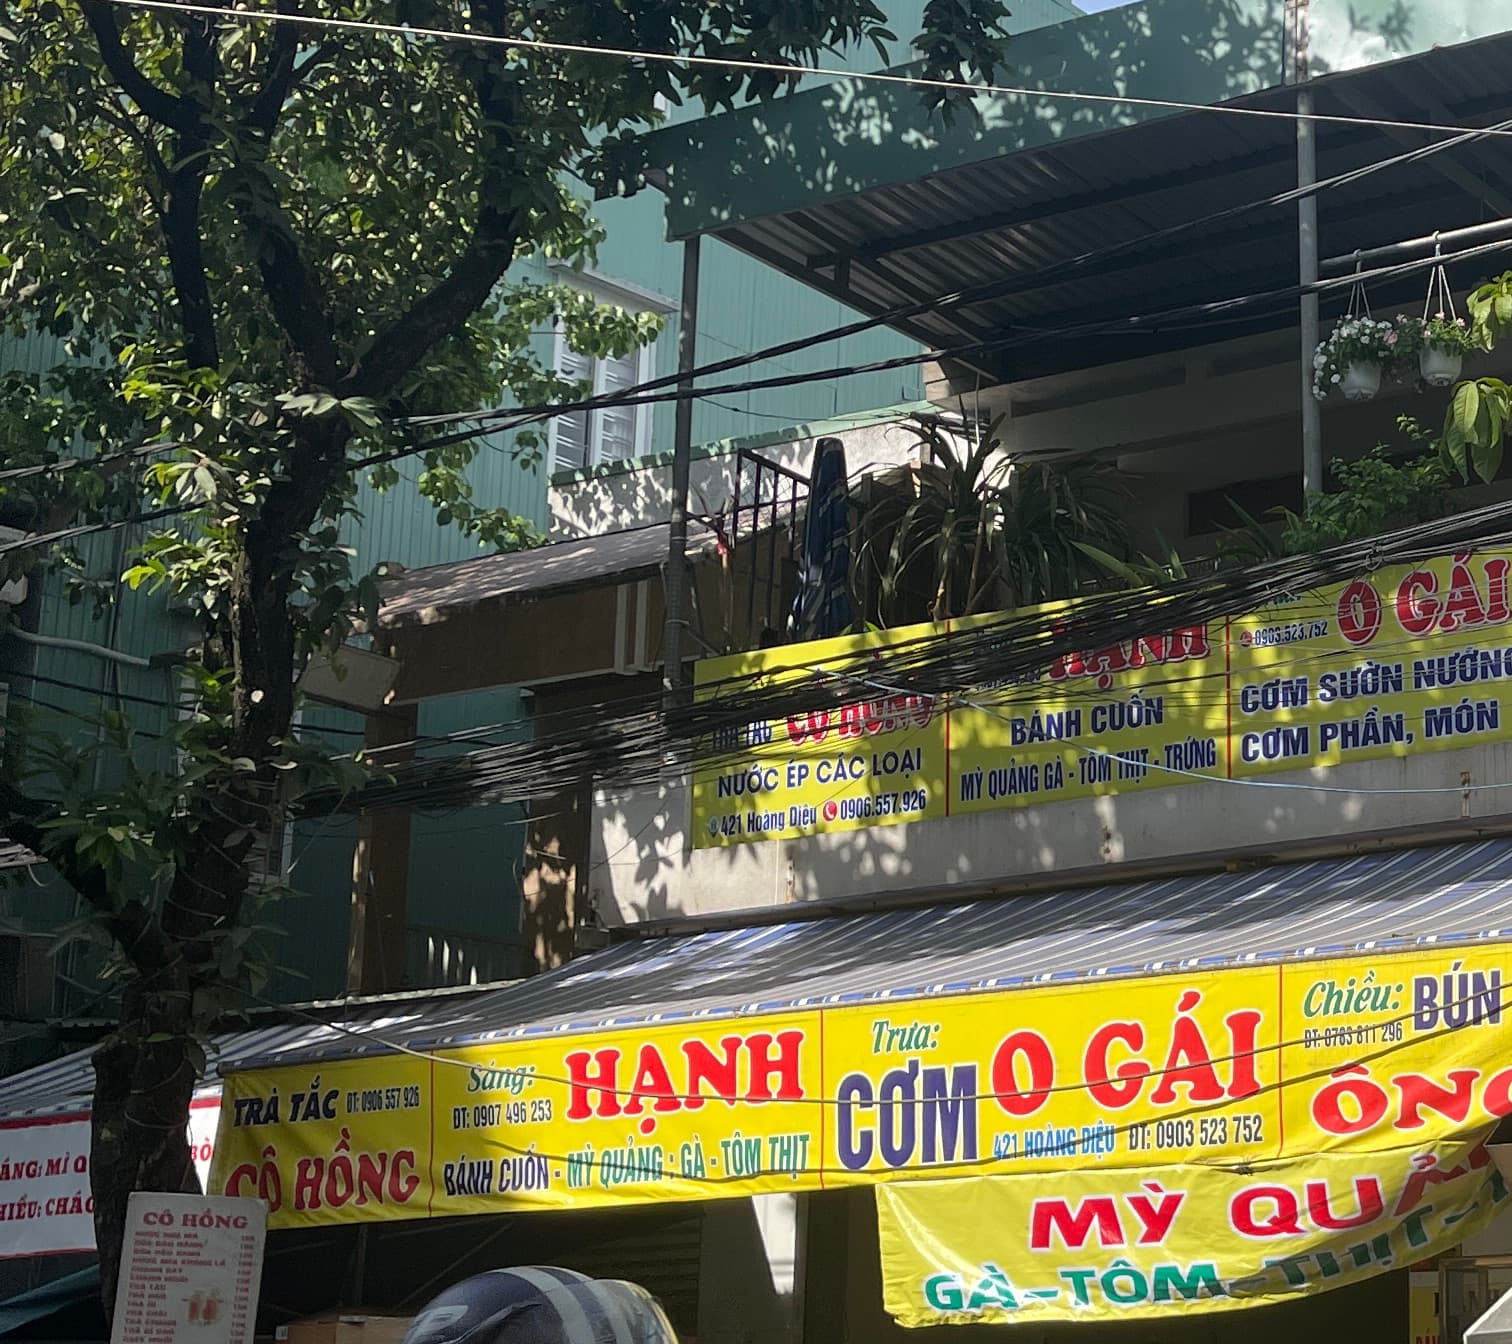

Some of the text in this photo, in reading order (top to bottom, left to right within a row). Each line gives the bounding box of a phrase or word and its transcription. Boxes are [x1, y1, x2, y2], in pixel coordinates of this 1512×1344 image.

[1336, 549, 1512, 646] O GÁI
[1240, 682, 1307, 714] CƠM
[1318, 664, 1401, 703] SƯỜN
[1011, 689, 1164, 746] BÁNH CUỐN
[1240, 727, 1308, 763] CƠM
[1425, 699, 1498, 739] MÓN
[717, 746, 922, 798] NƯỚC ÉP CÁC LOẠI
[961, 736, 1216, 802] MỲ QUẢNG GÀ TÔM THỊT TRỨNG
[721, 791, 926, 837] 421 Hoàng Diệu 0906.557.926
[1303, 969, 1402, 1017] Chiều:
[1414, 960, 1502, 1031] BÚN
[872, 1018, 940, 1054] Trưa:
[1382, 1021, 1402, 1043] 296
[232, 1086, 280, 1127] TRÀ
[290, 1075, 339, 1122] TẮC
[361, 1090, 382, 1113] 0906
[384, 1087, 400, 1111] 557
[402, 1085, 420, 1109] 926
[467, 1061, 535, 1097] Sáng:
[564, 1028, 805, 1134] HẠNH
[836, 989, 1263, 1171] CƠM O GÁI
[452, 1099, 552, 1129] ĐT: 0907 496 253
[993, 1134, 1018, 1159] 421
[1025, 1123, 1078, 1157] HOÀNG
[1128, 1121, 1151, 1152] ĐT:
[1156, 1119, 1195, 1149] 0903
[1198, 1117, 1228, 1146] 523
[1232, 1114, 1264, 1144] 752
[0, 1156, 42, 1182] ÁNG:
[225, 1127, 421, 1214] CÔ HỒNG
[444, 1133, 810, 1197] BÁNH CUỐN MỲ QUẢNG GÀ TÔM THỊT
[0, 1194, 42, 1221] HIỀU:
[143, 1207, 249, 1229] CÔ HỒNG
[1031, 1182, 1184, 1250] MỲ
